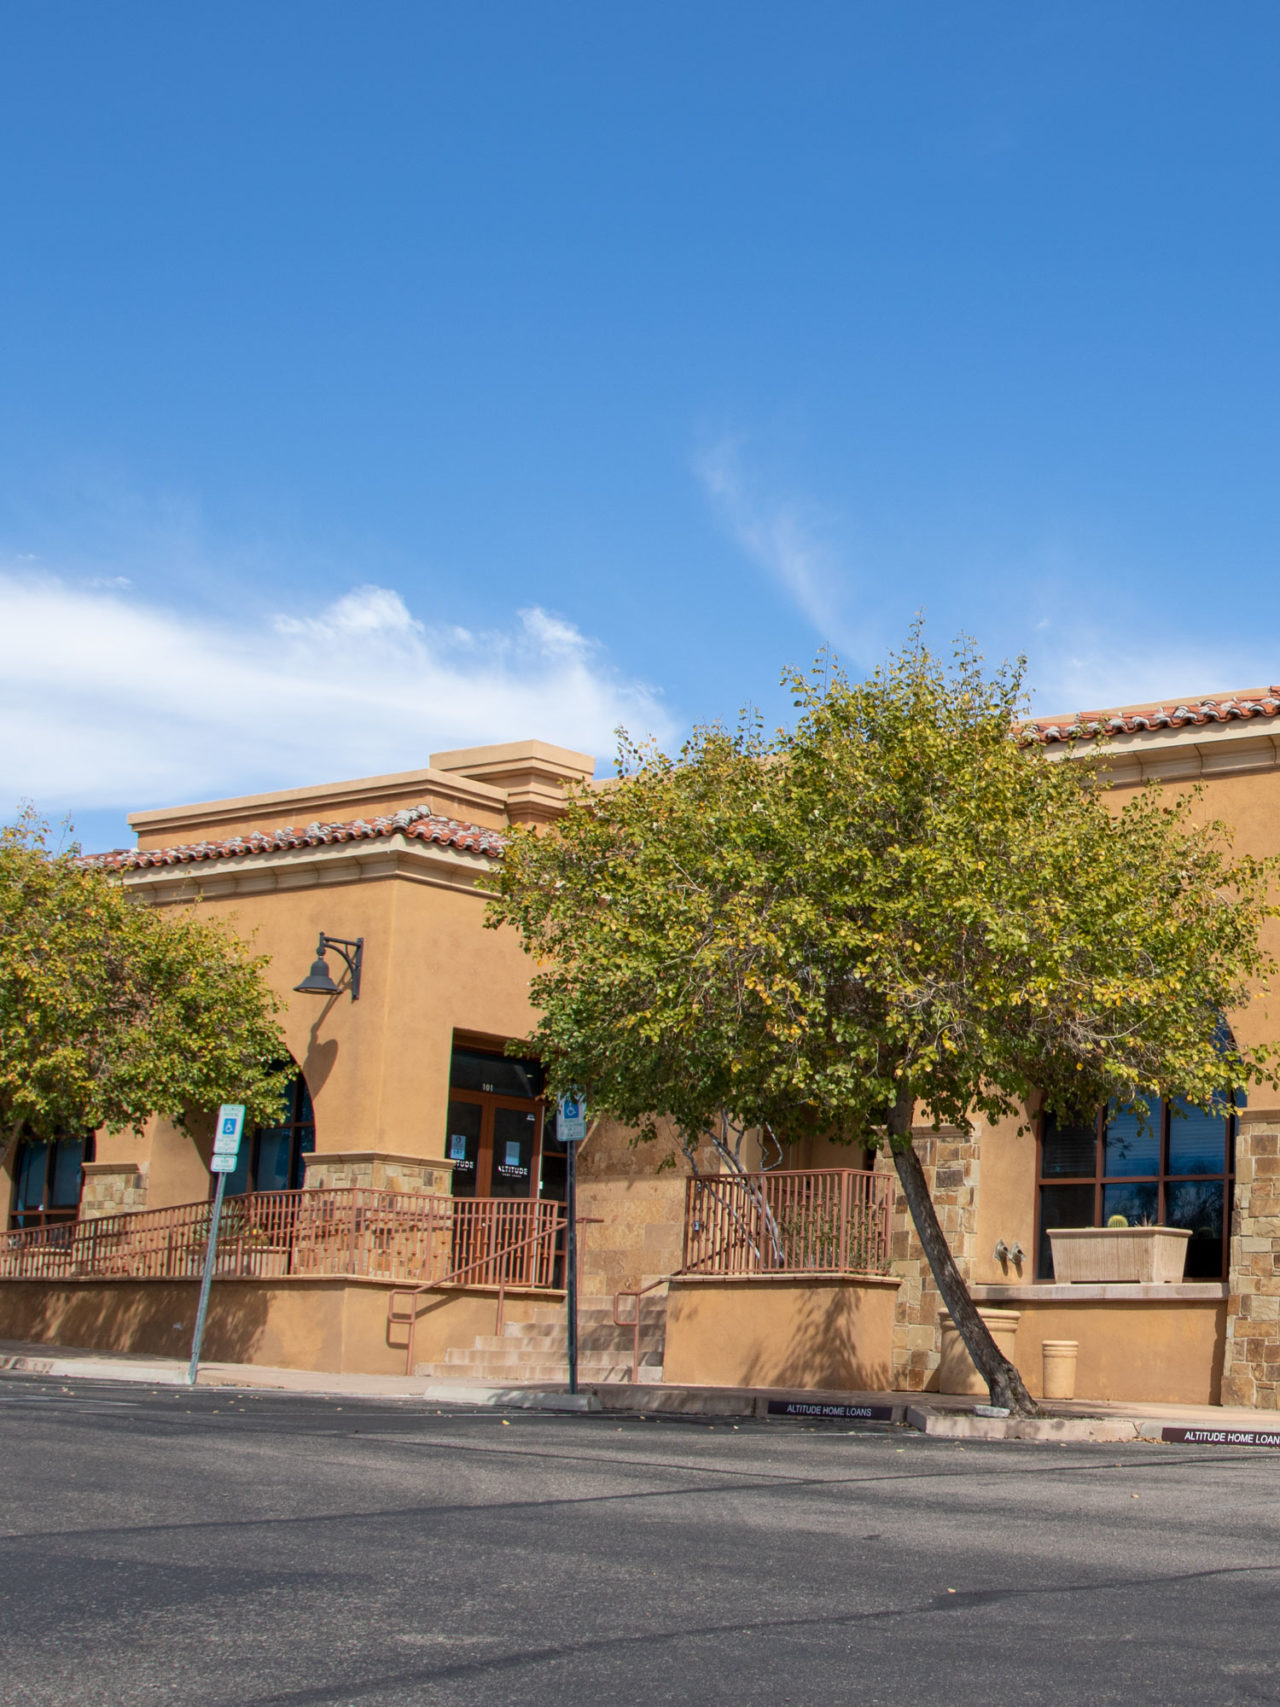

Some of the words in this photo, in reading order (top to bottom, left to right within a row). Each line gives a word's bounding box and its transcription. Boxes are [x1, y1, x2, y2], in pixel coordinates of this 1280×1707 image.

[498, 1165, 528, 1175] ALTITUDE
[787, 1404, 822, 1414] ALTITUDE
[822, 1406, 845, 1415] HOME
[846, 1408, 872, 1417] LOANS
[1184, 1431, 1226, 1442] ALTITUDE
[1227, 1433, 1254, 1443] HOME
